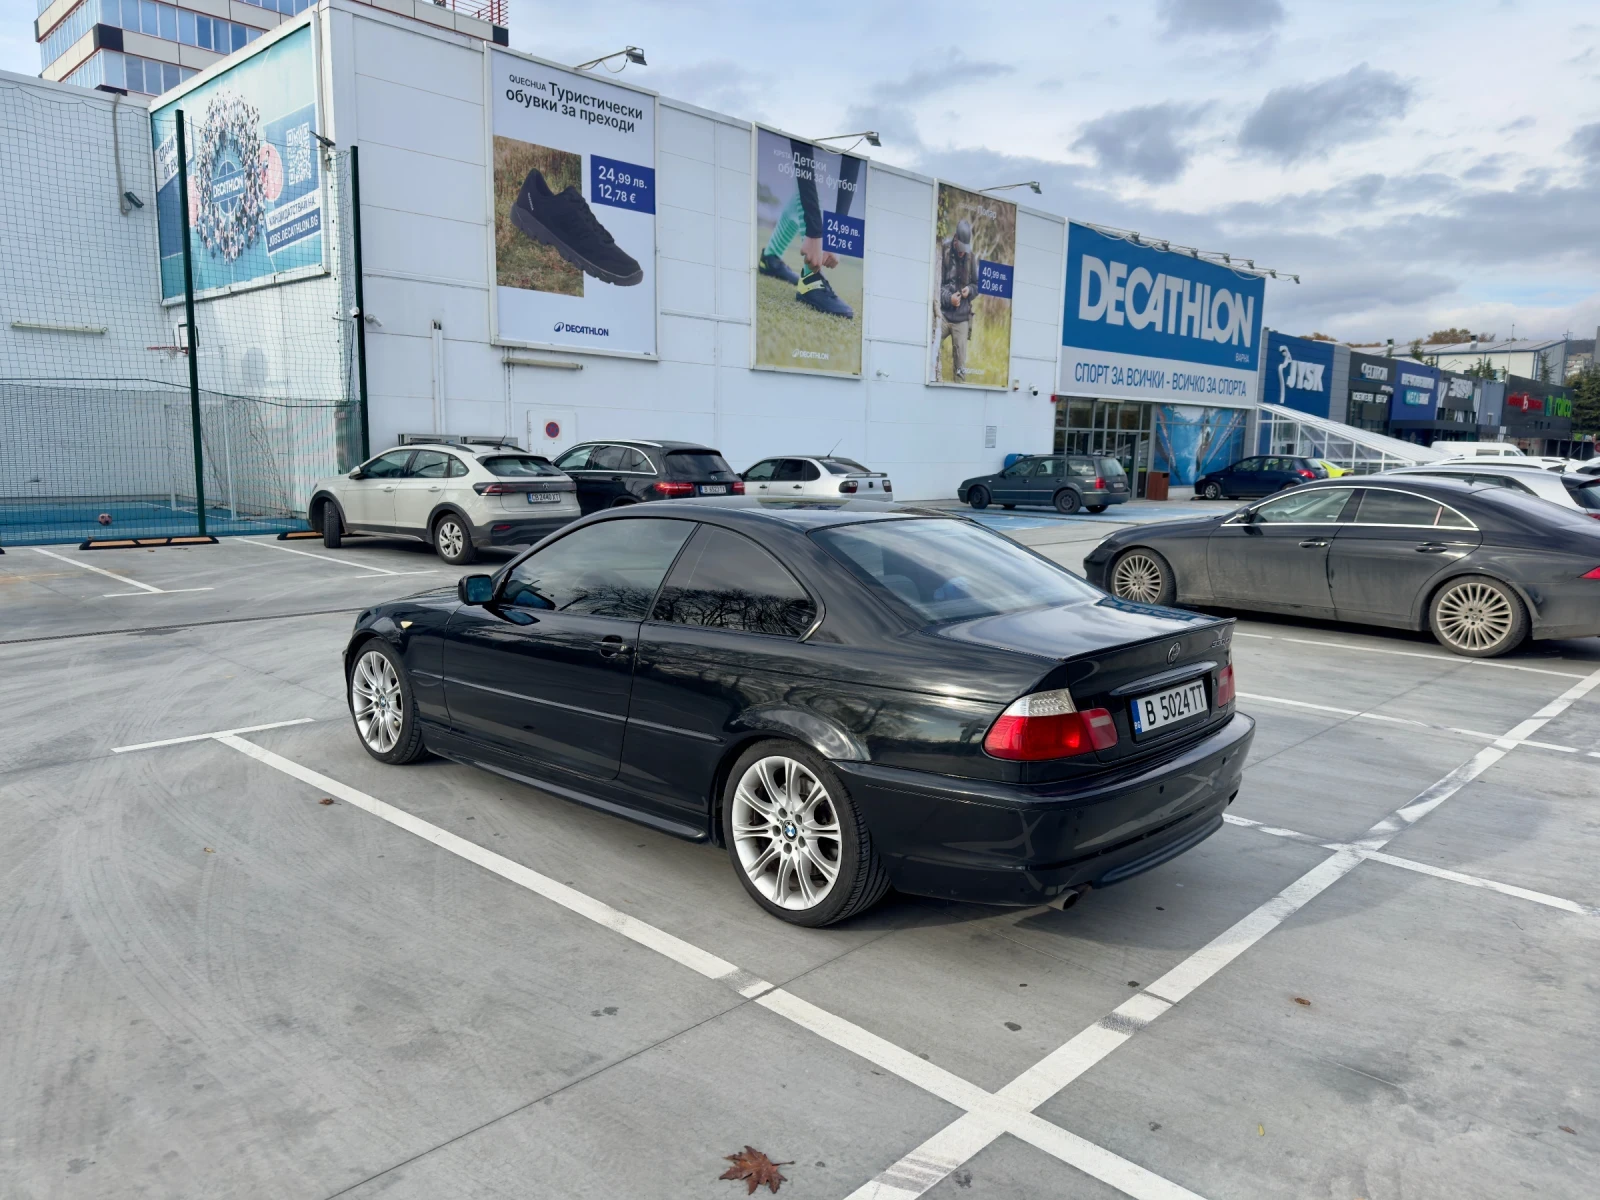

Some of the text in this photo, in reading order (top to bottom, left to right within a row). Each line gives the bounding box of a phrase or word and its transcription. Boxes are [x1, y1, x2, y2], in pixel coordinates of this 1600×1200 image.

[509, 74, 642, 120] QUECHUA Туристически
[506, 89, 634, 133] обувки за преходи
[792, 152, 827, 172] Детски
[212, 175, 244, 198] DECATHLON
[598, 166, 648, 189] 24,99 лв.
[778, 163, 858, 192] обувки за футбол
[598, 184, 636, 204] 12,78 €
[268, 214, 318, 247] JOBS.DECATHLON.BG
[828, 219, 860, 238] 24,99 лв.
[827, 234, 852, 250] 12,78 €
[982, 266, 1000, 280] 40,99
[982, 278, 1003, 292] 20,96 €
[1078, 254, 1254, 348] DECATHLON
[566, 324, 609, 336] DECATHLON
[800, 350, 829, 360] DECATHLON
[1074, 362, 1110, 383] СПОРТ
[1112, 366, 1124, 384] ЗА
[1126, 368, 1165, 389] ВСИЧКИ
[1172, 372, 1206, 392] ВСИЧКО
[1206, 376, 1216, 393] ЗА
[1218, 378, 1246, 396] СПОРТА
[1286, 360, 1325, 392] JYSK
[1145, 700, 1156, 726] B
